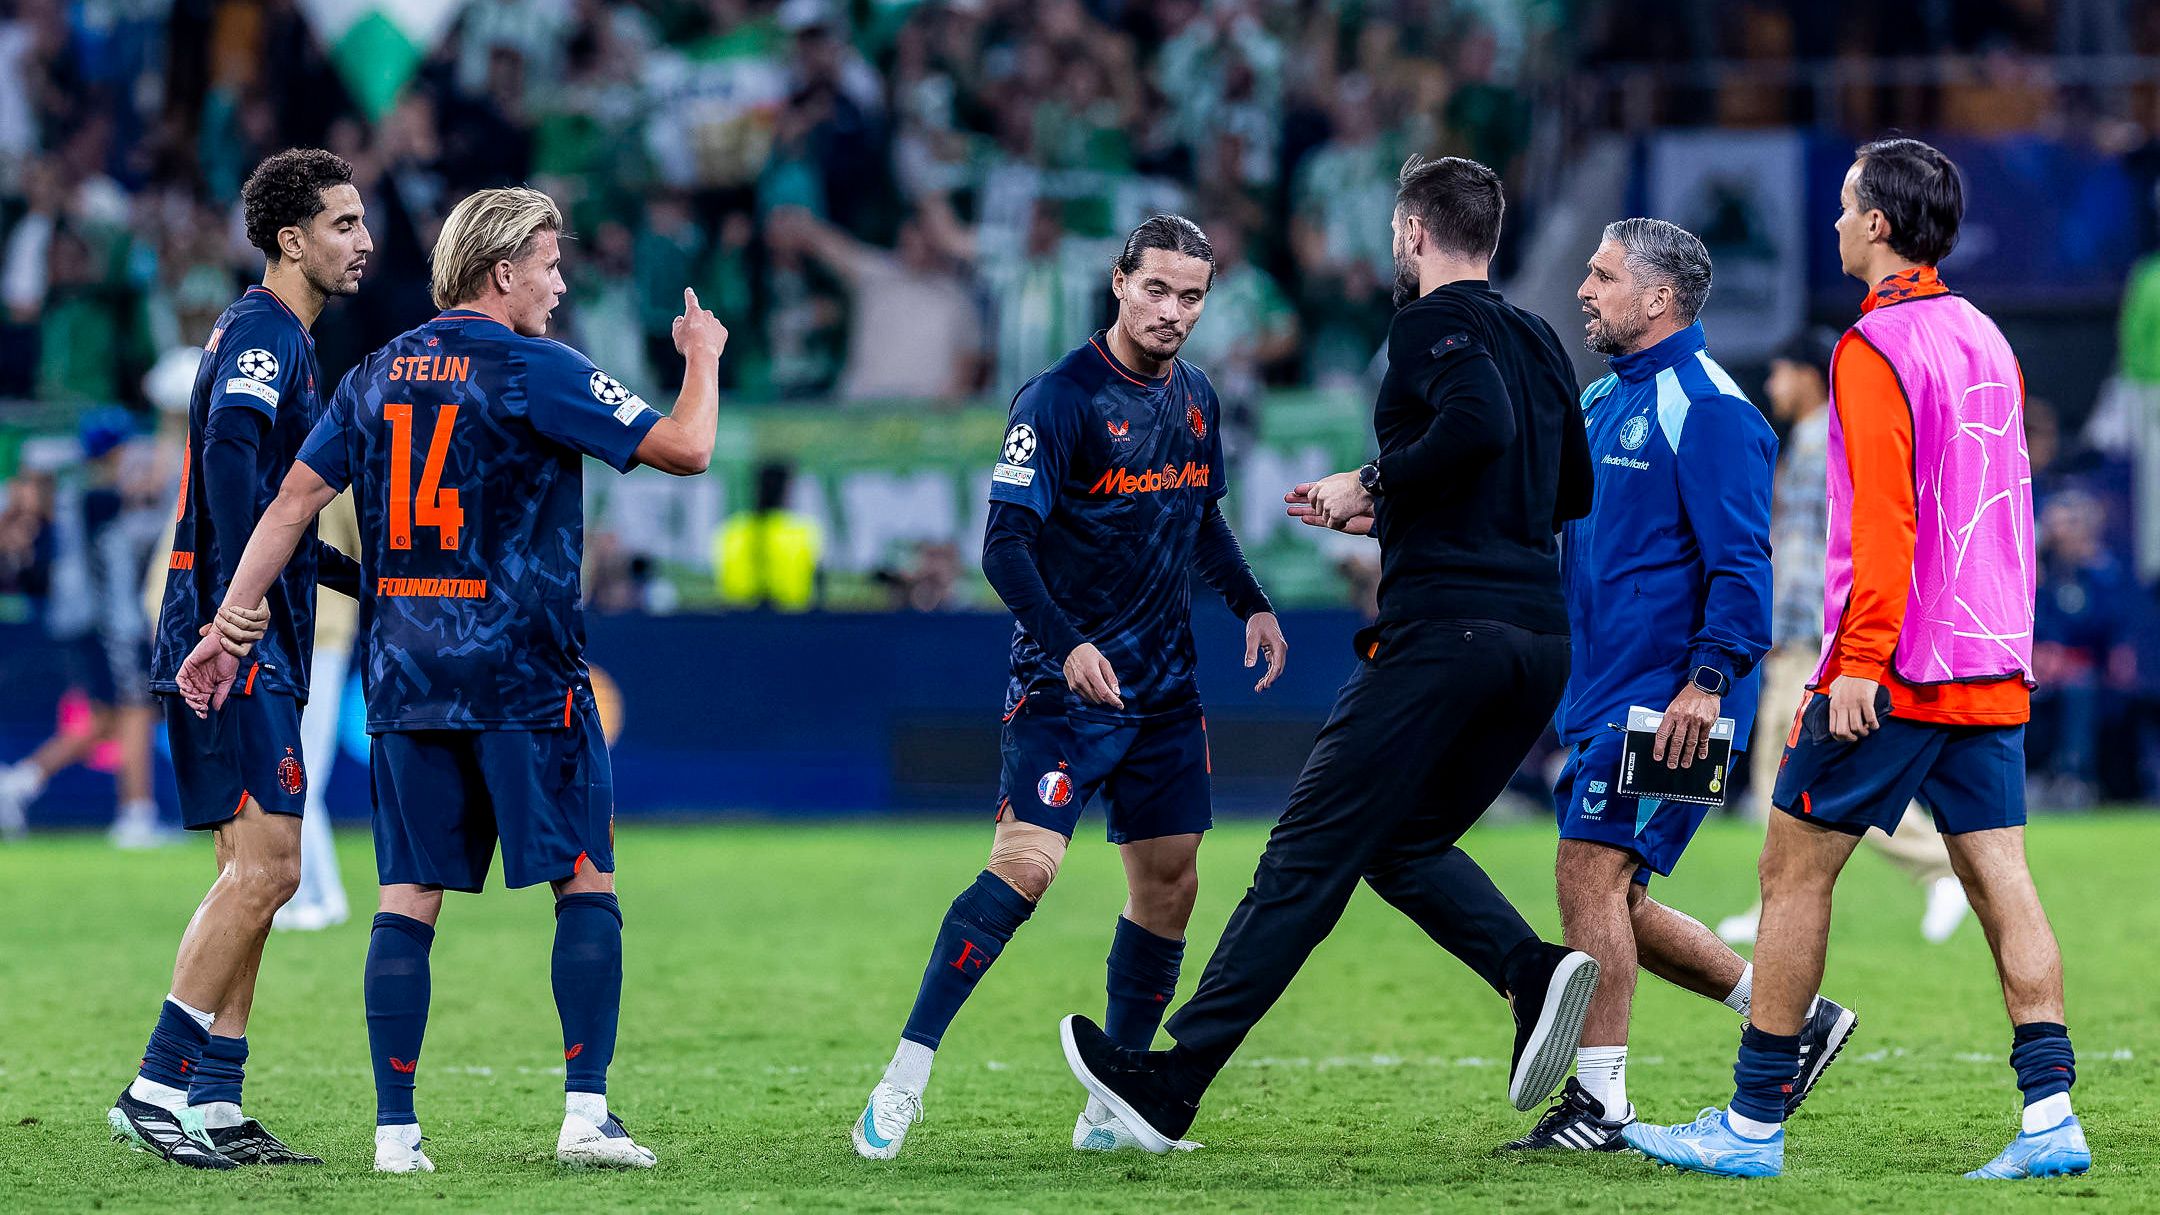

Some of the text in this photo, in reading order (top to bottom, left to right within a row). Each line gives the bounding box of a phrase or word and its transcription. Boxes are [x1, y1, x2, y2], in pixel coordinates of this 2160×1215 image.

[388, 355, 470, 382] STEIJN
[383, 403, 465, 551] 14
[376, 577, 488, 599] FOUNDATION
[1588, 780, 1608, 794] SB
[1626, 770, 1634, 785] TOP
[949, 938, 992, 973] F
